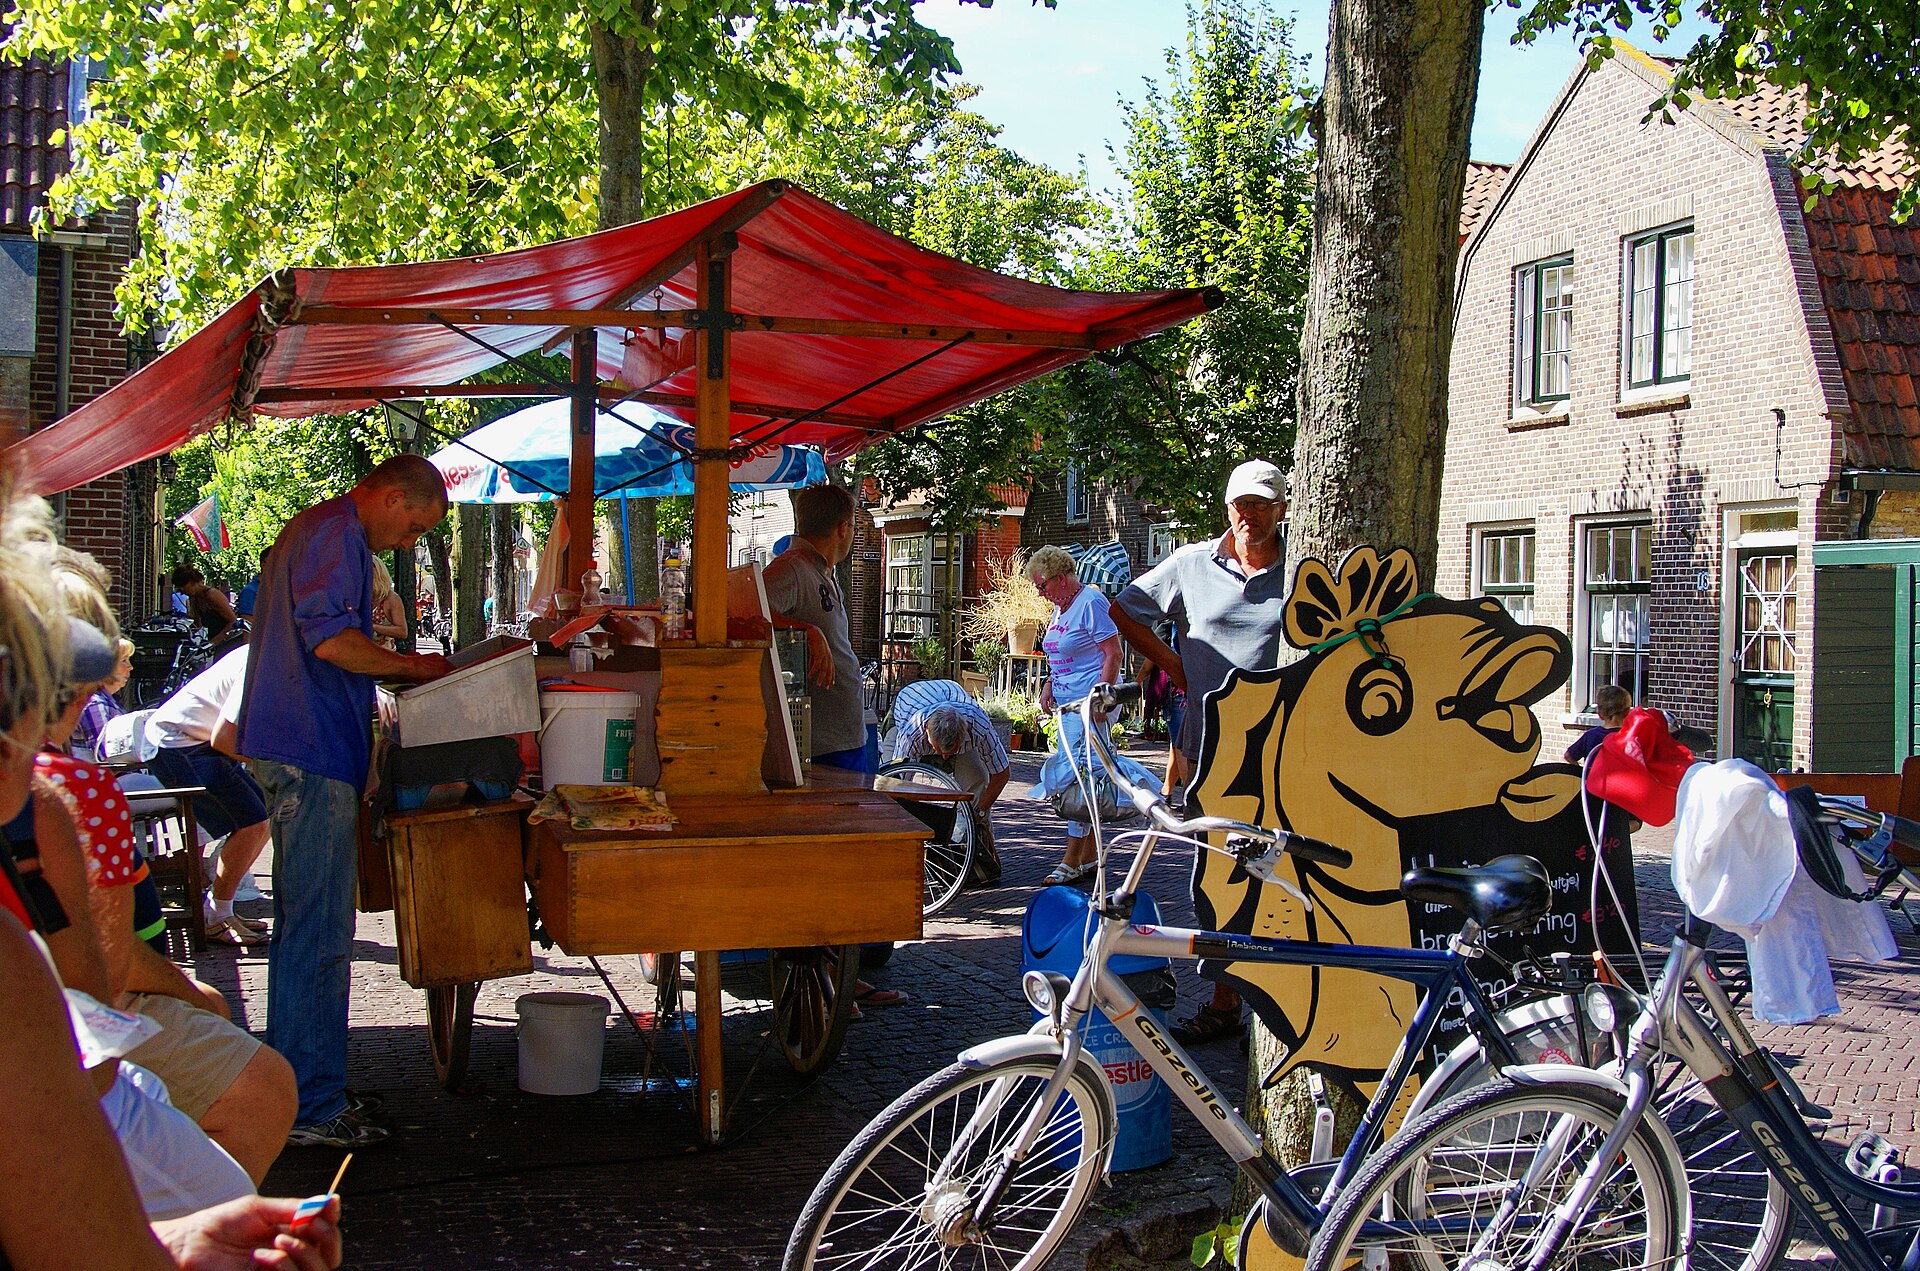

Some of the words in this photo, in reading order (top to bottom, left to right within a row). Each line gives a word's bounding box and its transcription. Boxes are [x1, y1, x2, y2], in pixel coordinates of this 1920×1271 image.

[1698, 574, 1708, 588] 18
[1134, 1015, 1229, 1121] Gazelle
[1751, 1120, 1850, 1242] Gazelle
